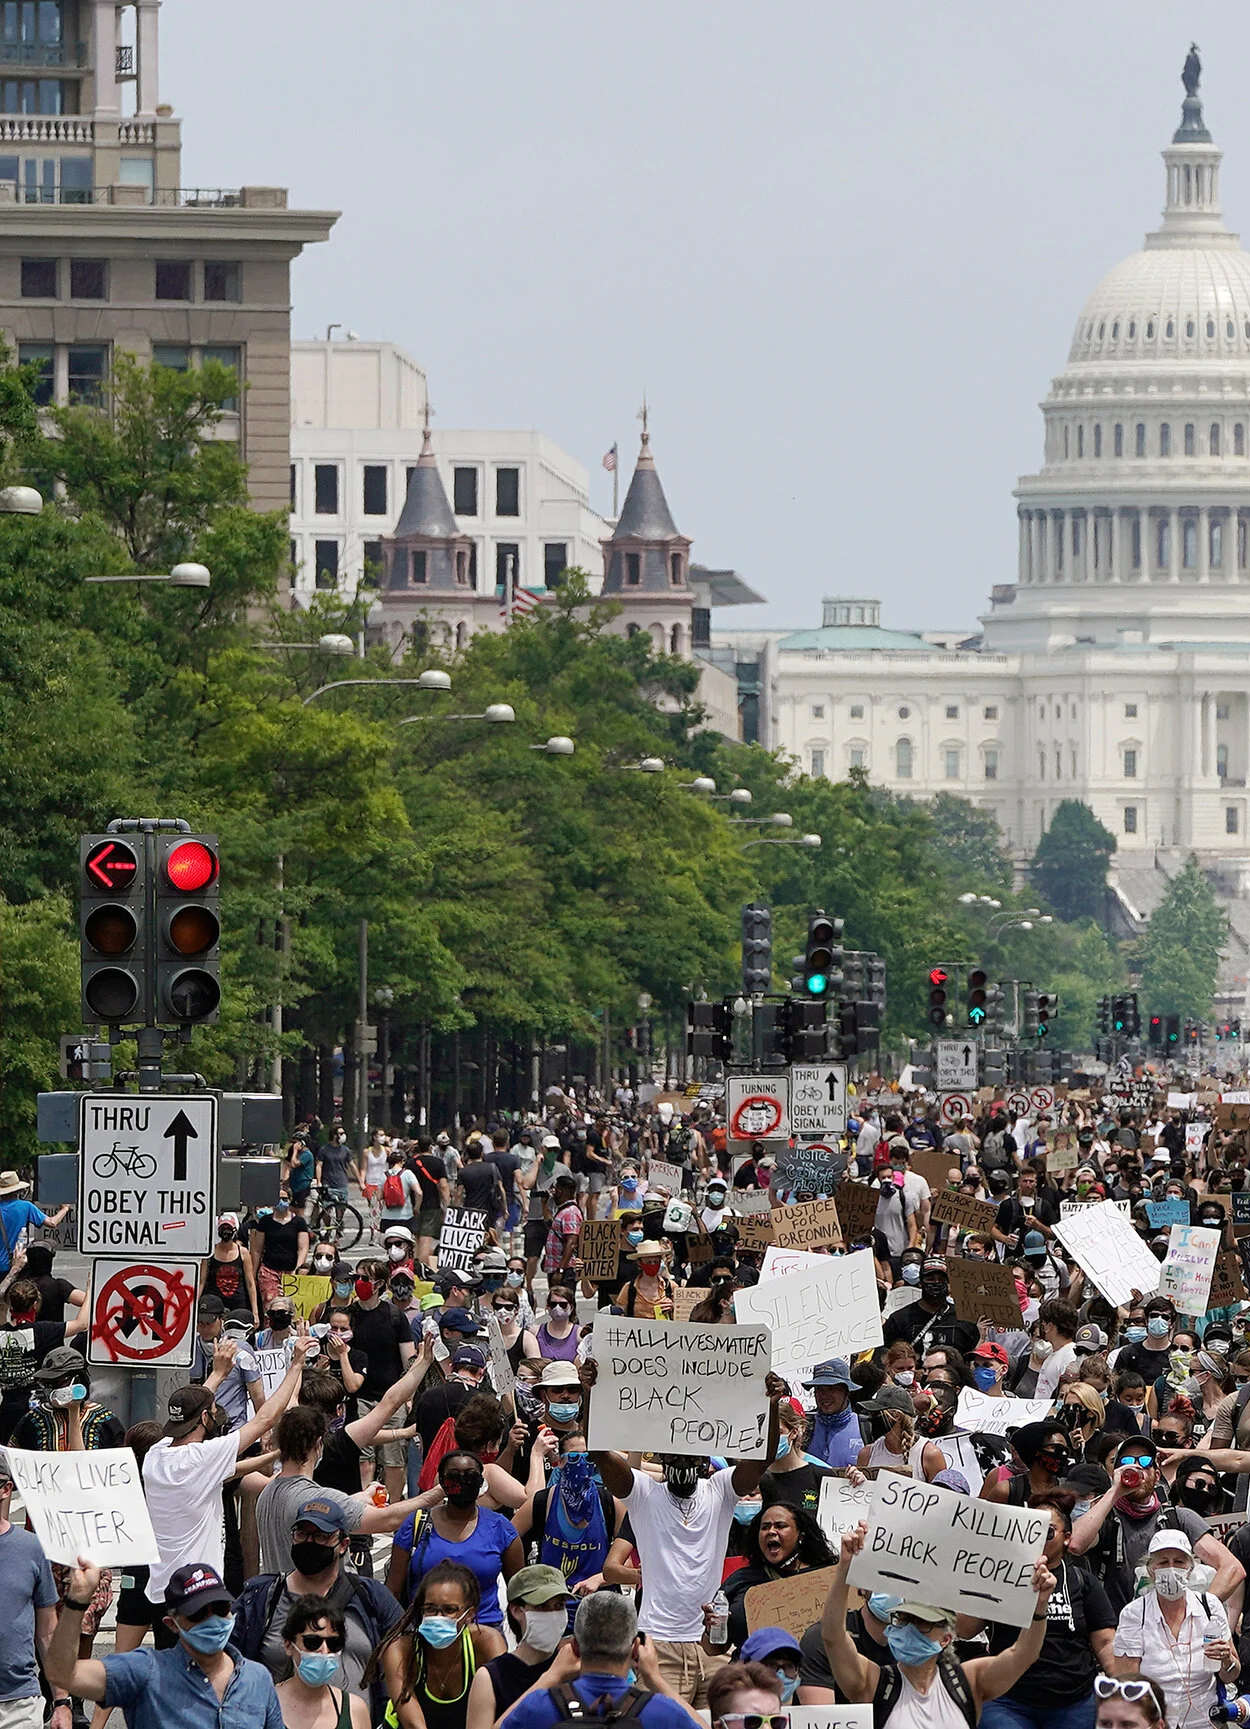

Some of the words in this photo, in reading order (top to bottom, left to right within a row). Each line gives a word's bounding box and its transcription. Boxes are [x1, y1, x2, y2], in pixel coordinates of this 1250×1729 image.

[794, 1070, 820, 1080] THRU
[741, 1084, 776, 1094] TURNING
[91, 1107, 150, 1131] THRU
[794, 1106, 819, 1116] OBEY
[824, 1104, 843, 1115] THIS
[794, 1118, 827, 1128] SIGNAL
[790, 1150, 830, 1162] JUSTICE
[88, 1190, 148, 1214] OBEY
[157, 1190, 206, 1214] THIS
[774, 1199, 835, 1224] JUSTICE
[942, 1192, 970, 1206] BLACK
[974, 1202, 999, 1218] LIVES
[445, 1208, 488, 1230] BLACK
[729, 1216, 773, 1228] SILENC
[792, 1214, 818, 1228] FOR
[936, 1204, 990, 1231] MATTER
[64, 1228, 78, 1246] AL
[87, 1220, 166, 1245] SIGNAL
[442, 1230, 484, 1250] LIVES
[584, 1224, 617, 1241] BLACK
[778, 1222, 841, 1248] BREONNA
[1178, 1228, 1192, 1247] I
[438, 1250, 474, 1272] MATTE
[582, 1242, 616, 1261] LIVES
[770, 1256, 809, 1276] Firs
[981, 1269, 1010, 1287] LIVES
[675, 1290, 700, 1298] BLACK
[750, 1269, 870, 1331] SILENCE
[962, 1301, 1014, 1321] MATTER
[792, 1317, 829, 1344] IS
[605, 1327, 768, 1358] #ALLLIVESMATTER
[772, 1315, 880, 1368] IOLENCE
[256, 1353, 286, 1372] RIOTS
[612, 1357, 669, 1378] DOES
[681, 1357, 754, 1378] INCLUDE
[618, 1386, 705, 1413] BLACK
[670, 1412, 766, 1453] PEOPLE!
[14, 1458, 62, 1493] BLACK
[78, 1461, 131, 1490] LIVES
[665, 1464, 681, 1484] TRY
[683, 1466, 699, 1484] ME
[882, 1480, 940, 1516] STOP
[951, 1501, 1042, 1545] KILLING
[44, 1509, 134, 1548] MATTER
[830, 1514, 856, 1535] hea
[544, 1534, 601, 1551] VESPOLI
[872, 1526, 939, 1567] BLACK
[953, 1548, 1033, 1588] PEOPLE
